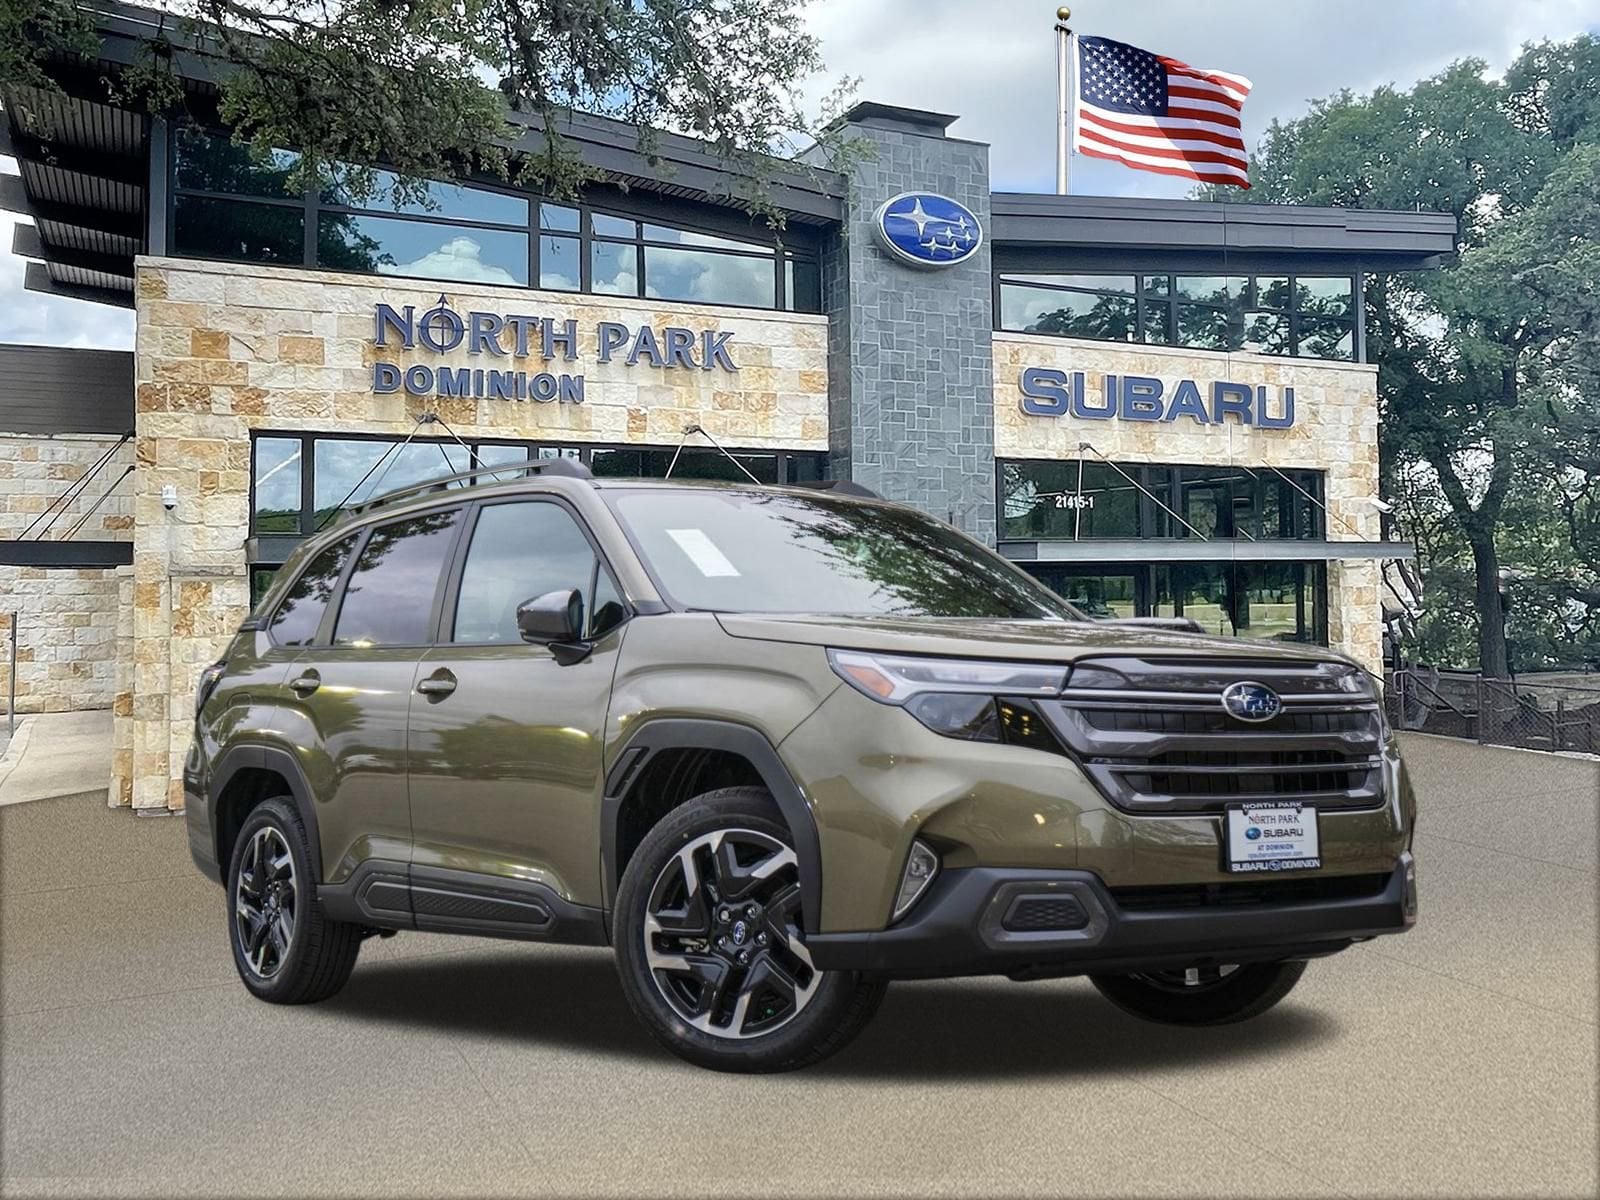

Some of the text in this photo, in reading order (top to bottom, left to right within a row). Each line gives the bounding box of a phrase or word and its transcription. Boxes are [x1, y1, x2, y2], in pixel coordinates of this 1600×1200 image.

[374, 293, 741, 373] NORTH PARK
[373, 362, 585, 404] DOMINION
[1019, 366, 1295, 429] SUBARU
[1248, 815, 1300, 825] NORTH PARK
[1263, 828, 1304, 838] SUBARU
[1231, 859, 1320, 872] SUBARU DOMINION
